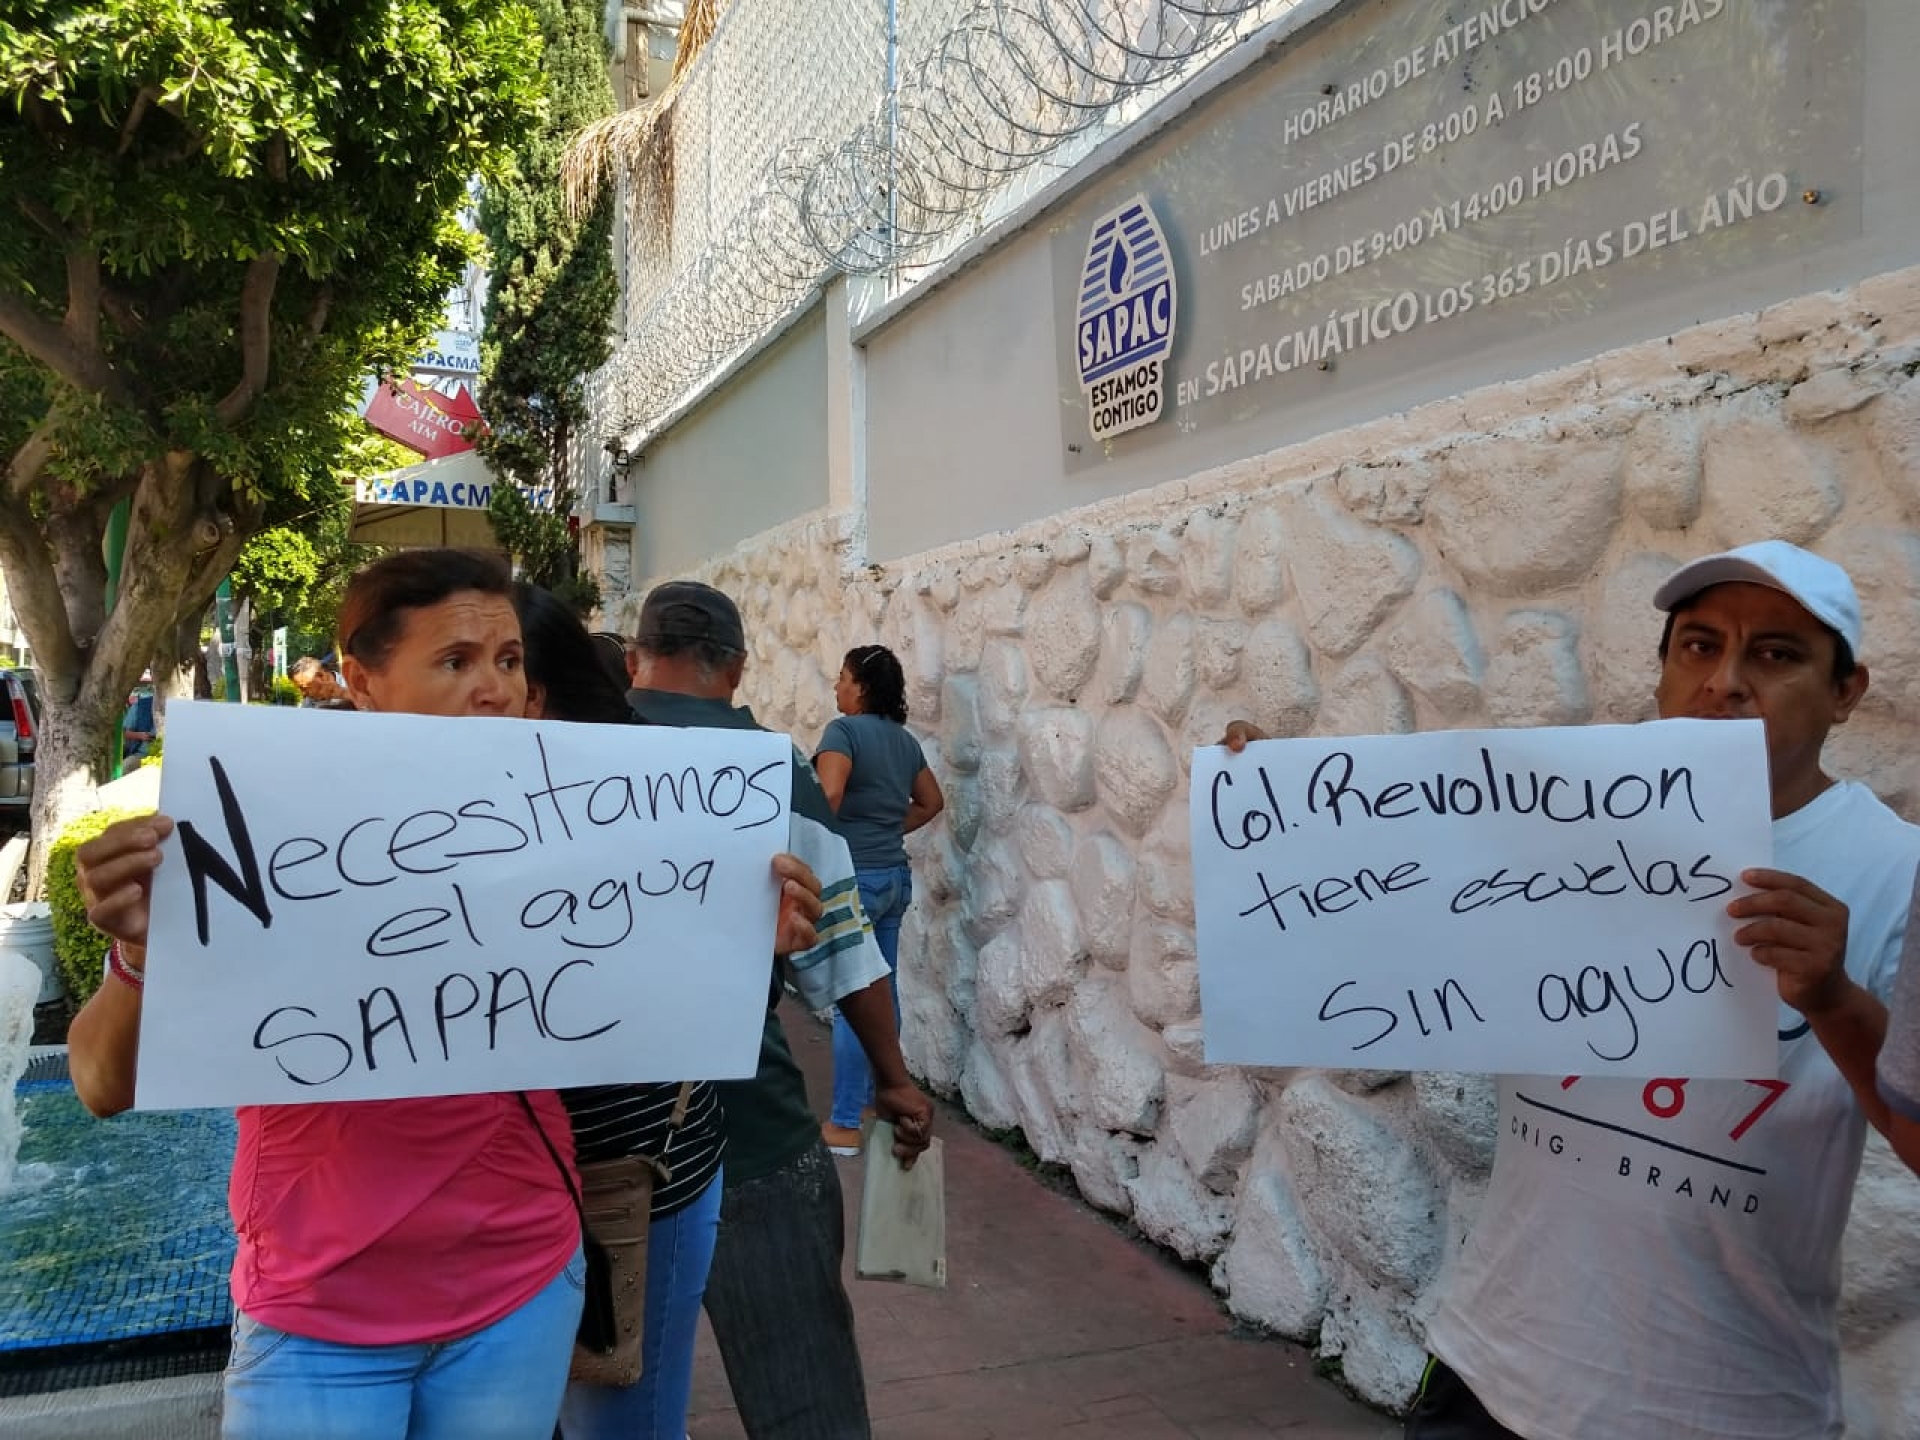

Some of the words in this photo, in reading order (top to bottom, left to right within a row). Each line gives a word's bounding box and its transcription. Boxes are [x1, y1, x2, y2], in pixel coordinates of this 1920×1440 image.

[1199, 207, 1261, 256] LUNES
[1265, 199, 1280, 226] A
[1283, 151, 1377, 217] VIERNES
[1382, 132, 1416, 173] DE
[1421, 104, 1478, 153] 8:00
[1484, 92, 1504, 126] A
[1600, 0, 1725, 71] HORAS
[1283, 69, 1387, 145] HORARIO
[1394, 46, 1426, 88] DE
[1240, 253, 1329, 311] SABADO
[1335, 239, 1366, 276] DE
[1370, 217, 1423, 261] 9:00
[1531, 122, 1642, 198] HORAS
[1080, 283, 1168, 371] SAPAC
[1176, 377, 1200, 407] EN
[1205, 290, 1419, 396] SAPACMÁTICO
[1424, 280, 1475, 324] LOS
[1481, 261, 1531, 305] 365
[1540, 231, 1614, 287] DÍAS
[1622, 208, 1689, 260] DEL
[1698, 172, 1788, 235] AÑO
[396, 394, 464, 435] CAJERO
[408, 420, 437, 442] ATM
[1091, 360, 1159, 408] ESTAMOS
[1092, 391, 1159, 433] CONTIGO
[177, 732, 787, 947] Necesitamos
[1211, 767, 1300, 851] Col.
[1307, 748, 1706, 827] Revolucion
[366, 883, 484, 957] el
[520, 858, 715, 949] agua
[1239, 860, 1431, 932] tiene
[1449, 840, 1734, 914] escuelas
[253, 960, 621, 1086] SAPAC
[1537, 938, 1735, 1062] agua
[1617, 1156, 1760, 1215] BRAND
